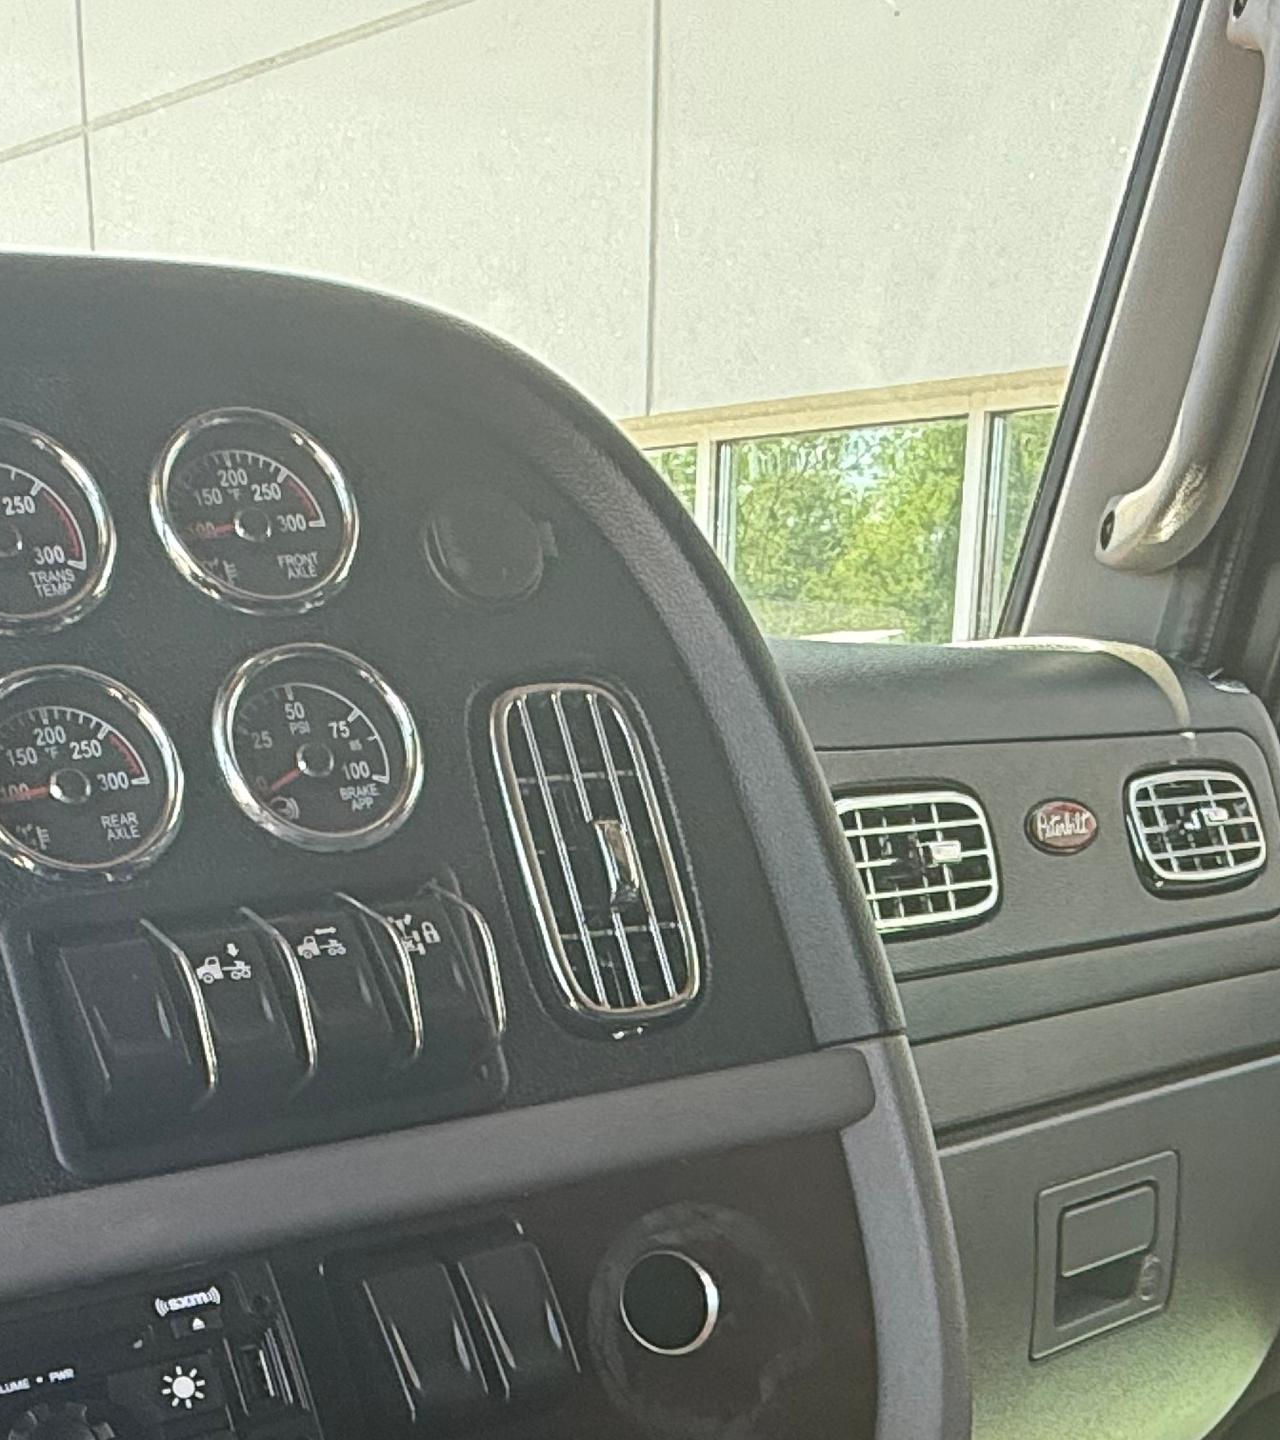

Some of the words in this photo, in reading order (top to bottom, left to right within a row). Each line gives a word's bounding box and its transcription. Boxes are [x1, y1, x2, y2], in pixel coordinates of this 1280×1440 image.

[217, 468, 248, 487] 200
[194, 487, 223, 507] 150
[251, 482, 282, 501] 250
[2, 495, 36, 516] 250
[277, 513, 307, 532] 300
[34, 545, 66, 566] 300
[277, 551, 319, 570] FRONT
[29, 568, 76, 587] TRANS
[287, 565, 318, 580] AXLE
[34, 583, 73, 598] TEMP
[284, 701, 305, 719] 50
[33, 725, 67, 746] 200
[289, 721, 311, 736] PSI
[328, 720, 351, 739] 75
[70, 739, 103, 760] 250
[251, 731, 273, 750] 25
[6, 746, 39, 768] 150
[342, 761, 371, 781] 100
[96, 771, 129, 792] 300
[339, 783, 381, 801] BRAKE
[350, 797, 375, 812] APP
[100, 811, 140, 829] REAR
[106, 824, 142, 842] AXLE
